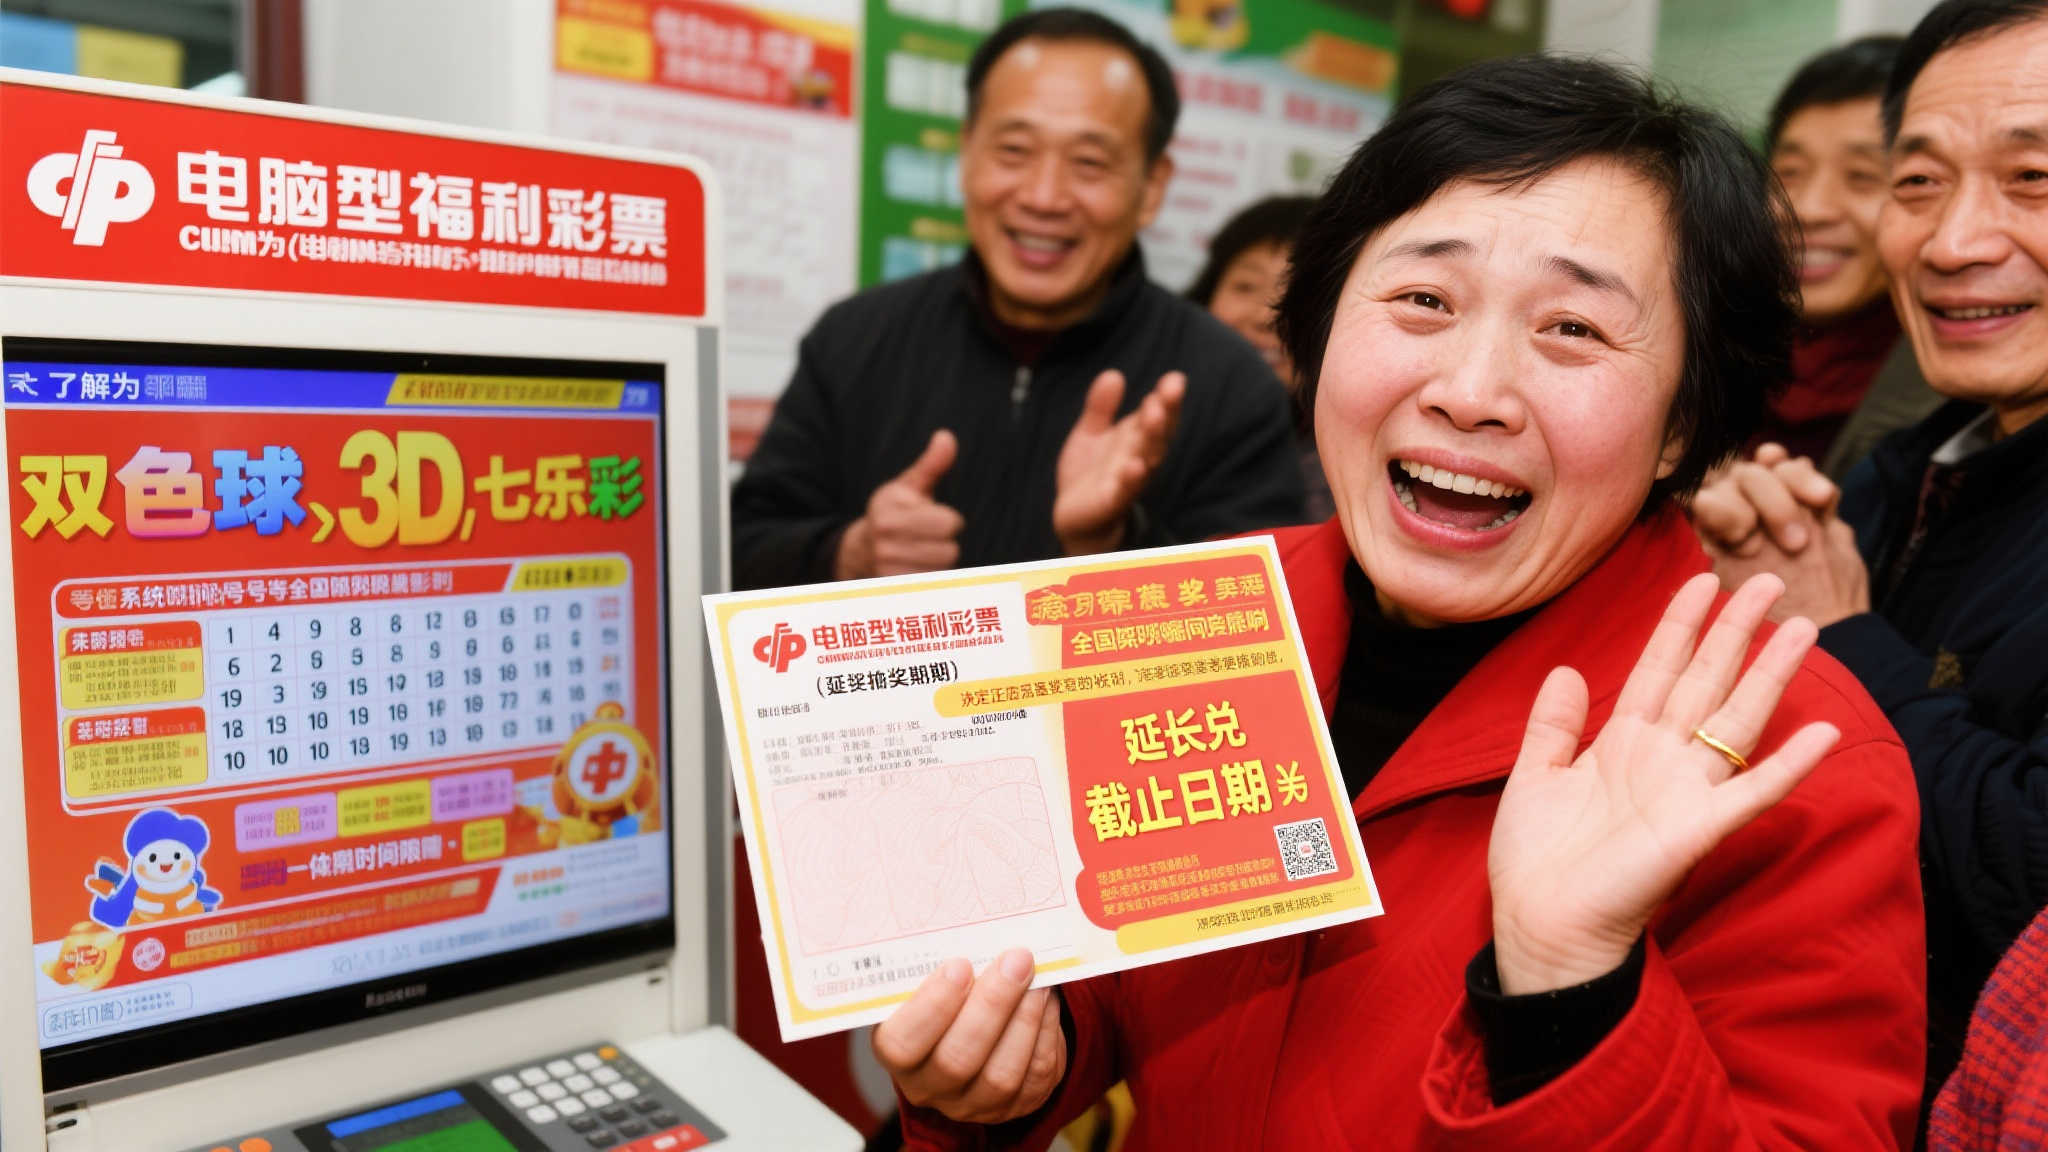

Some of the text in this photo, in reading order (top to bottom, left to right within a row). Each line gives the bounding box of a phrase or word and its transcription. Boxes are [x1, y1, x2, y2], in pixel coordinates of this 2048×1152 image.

[177, 150, 668, 258] 电脑型福利彩票
[227, 626, 233, 644] 1
[268, 622, 280, 641] 4
[310, 619, 322, 639] 9
[350, 617, 362, 637] 8
[812, 606, 1002, 650] 电脑型福利彩票
[228, 657, 241, 676] 6
[271, 653, 282, 673] 2
[220, 688, 242, 708] 19
[273, 685, 285, 704] 3
[1120, 700, 1247, 765] 延长兑
[224, 751, 246, 770] 10
[268, 746, 289, 766] 10
[309, 741, 329, 761] 10
[581, 741, 628, 795] 中
[1085, 759, 1273, 842] 截止日期
